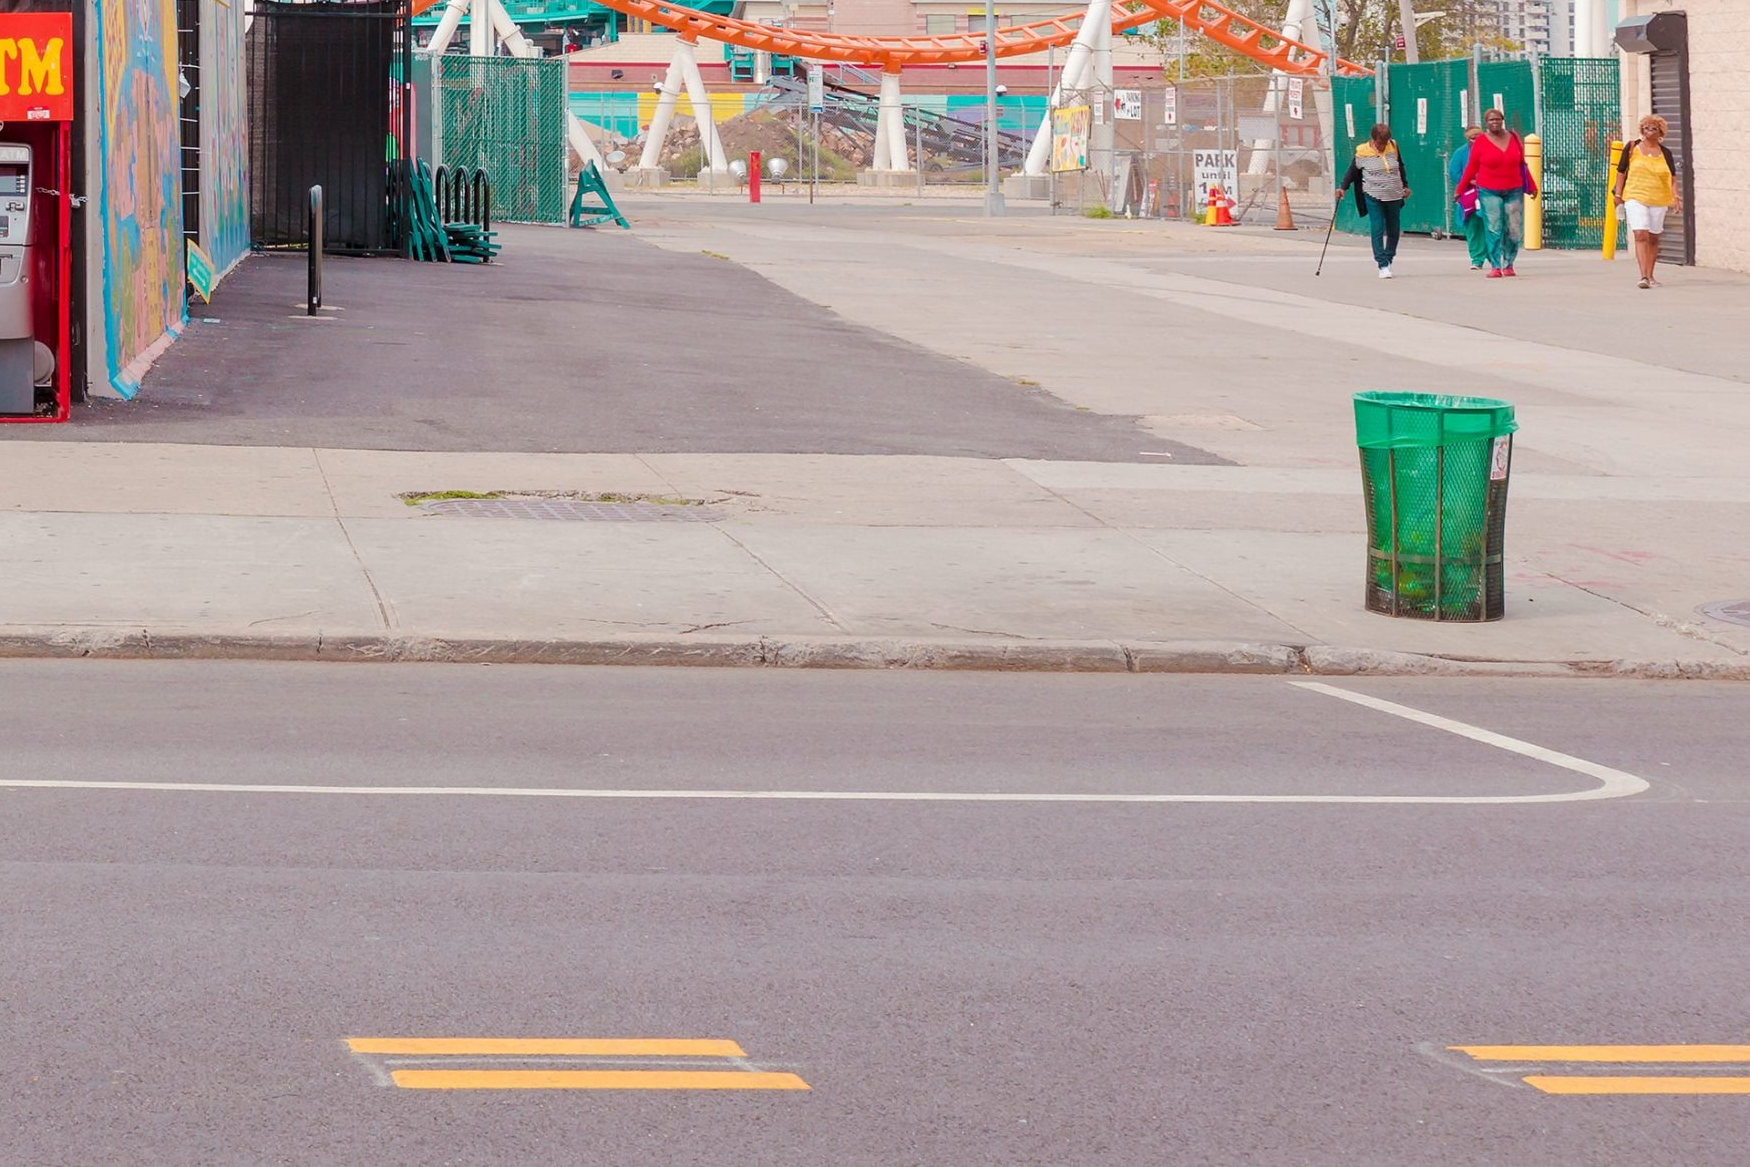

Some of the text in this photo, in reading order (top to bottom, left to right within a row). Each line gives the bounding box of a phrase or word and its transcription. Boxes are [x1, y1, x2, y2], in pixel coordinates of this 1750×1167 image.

[0, 150, 26, 159] ATM
[1195, 153, 1235, 168] PARK
[1201, 171, 1231, 180] unil
